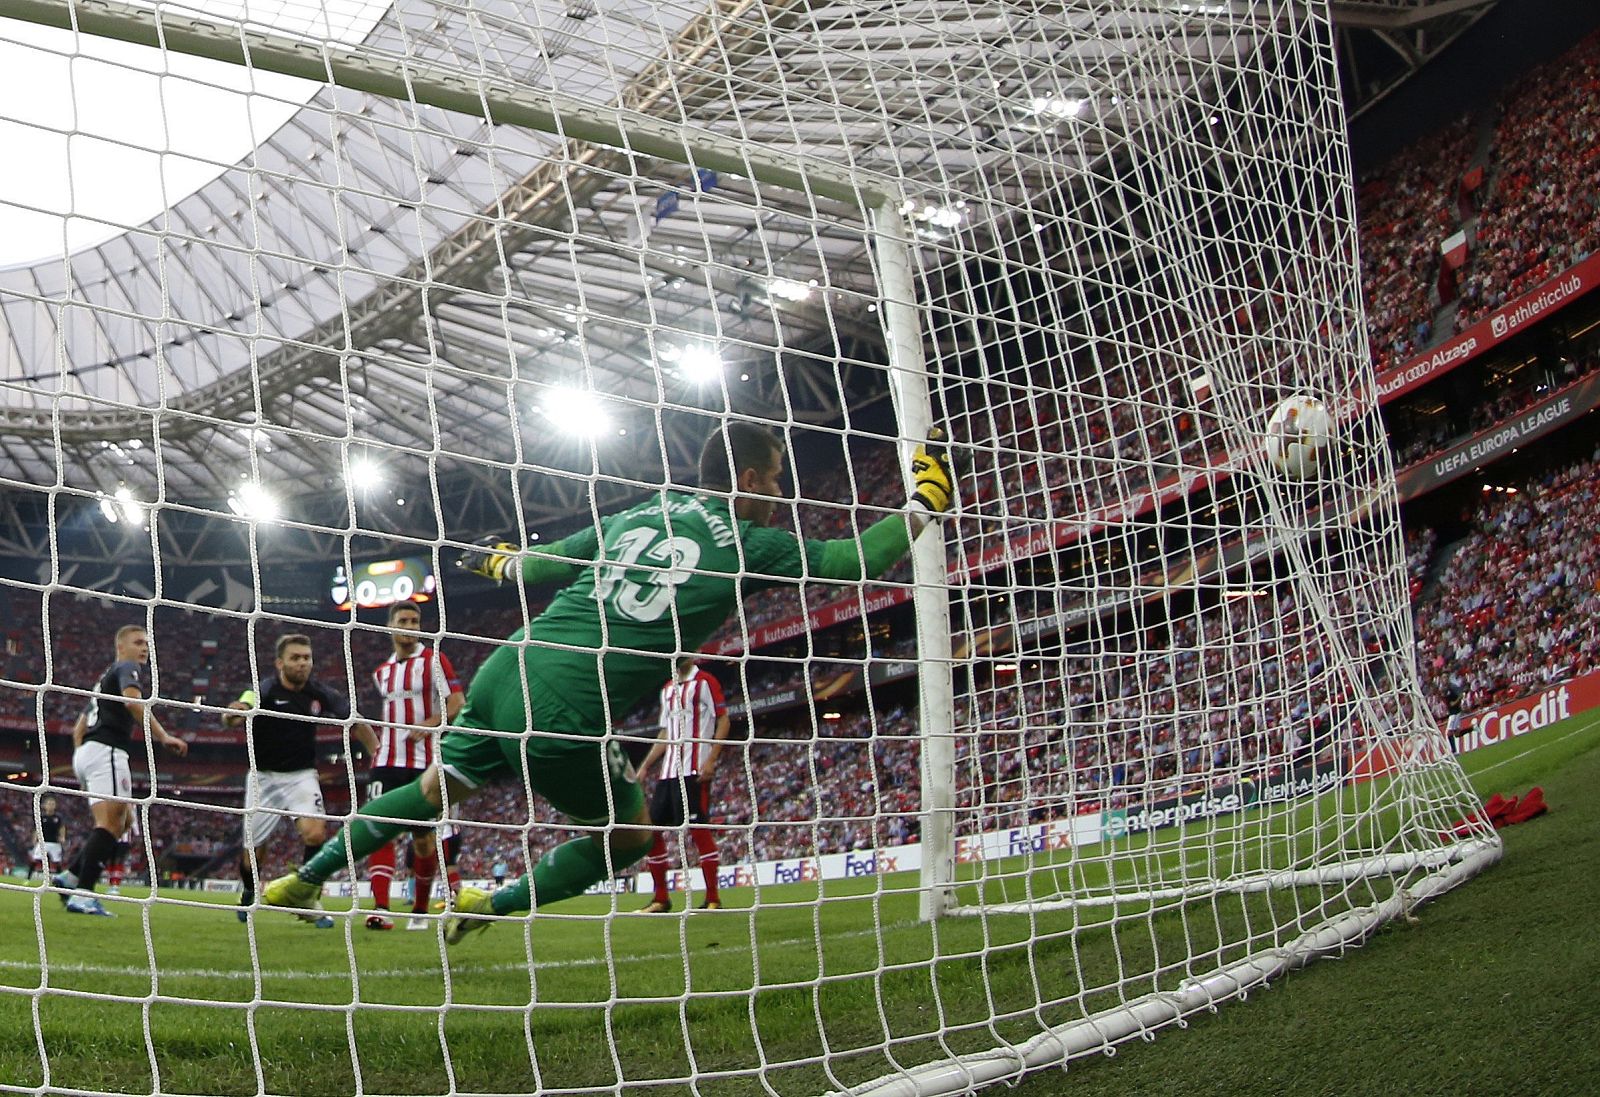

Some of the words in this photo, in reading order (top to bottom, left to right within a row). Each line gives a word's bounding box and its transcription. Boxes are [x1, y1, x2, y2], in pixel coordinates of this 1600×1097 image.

[1508, 274, 1581, 328] athleticclub
[1375, 371, 1405, 396] Audi
[1432, 338, 1477, 371] Alzaga
[1435, 453, 1469, 476] UEFA
[1470, 426, 1519, 459] EUROPA
[1521, 398, 1571, 434] LEAGUE
[588, 526, 701, 623] 13
[356, 576, 414, 605] 0-0
[834, 591, 896, 622] kutxbank
[1105, 794, 1241, 836] enterprise
[1009, 825, 1071, 856] FedEx
[719, 866, 753, 889] edEx
[775, 860, 819, 884] FedEx
[846, 850, 898, 876] FedEx
